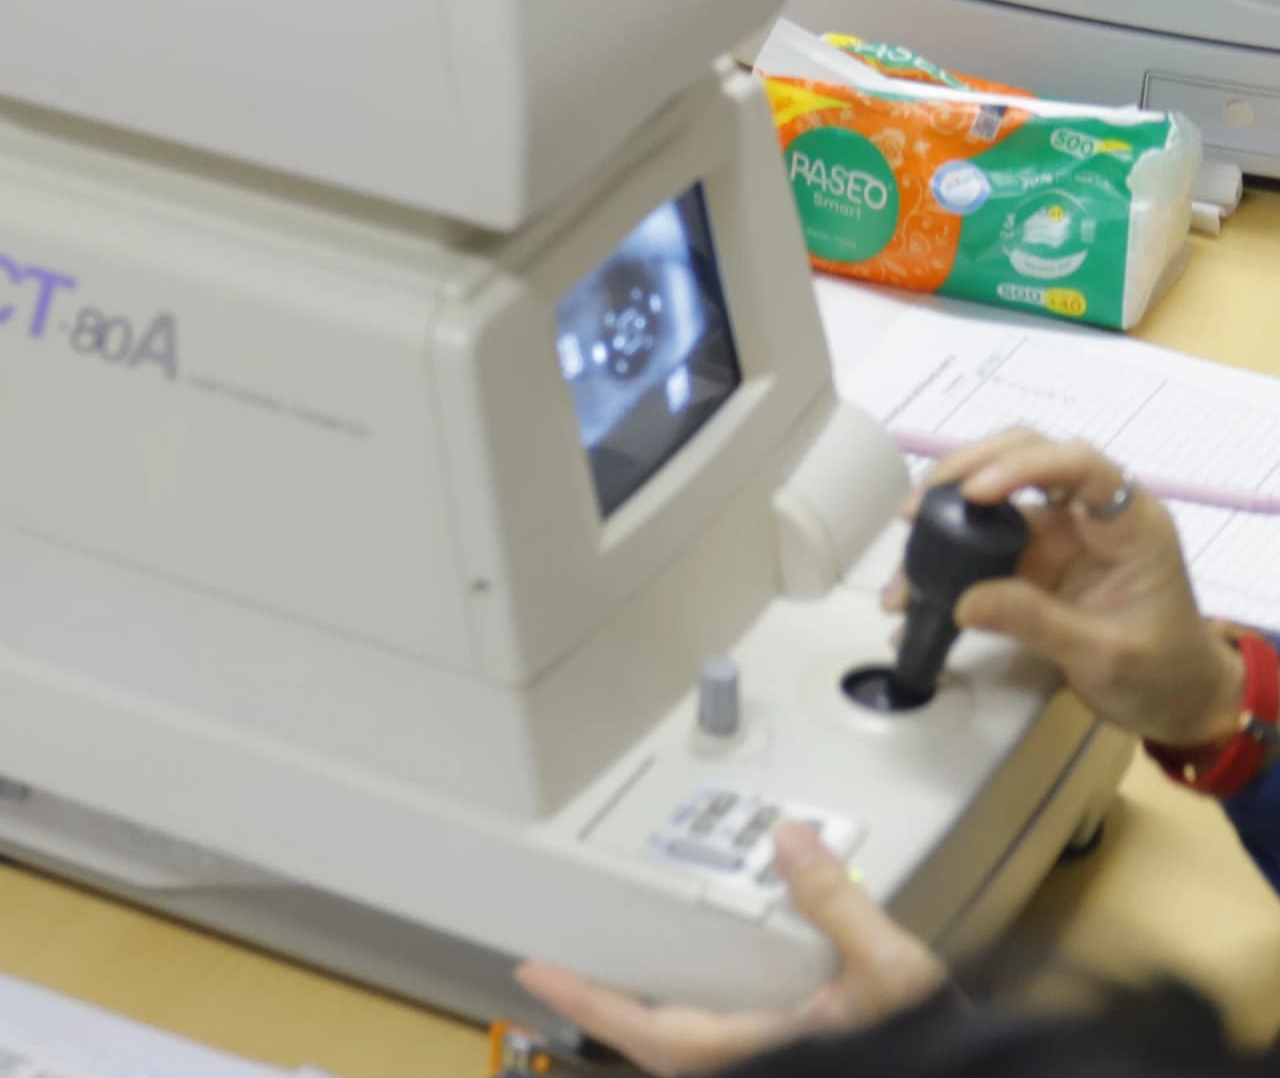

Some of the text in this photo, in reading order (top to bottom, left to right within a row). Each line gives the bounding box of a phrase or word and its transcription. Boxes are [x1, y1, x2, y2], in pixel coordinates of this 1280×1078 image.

[1055, 131, 1094, 155] 500
[790, 151, 888, 211] PASEO
[813, 192, 862, 219] Smart
